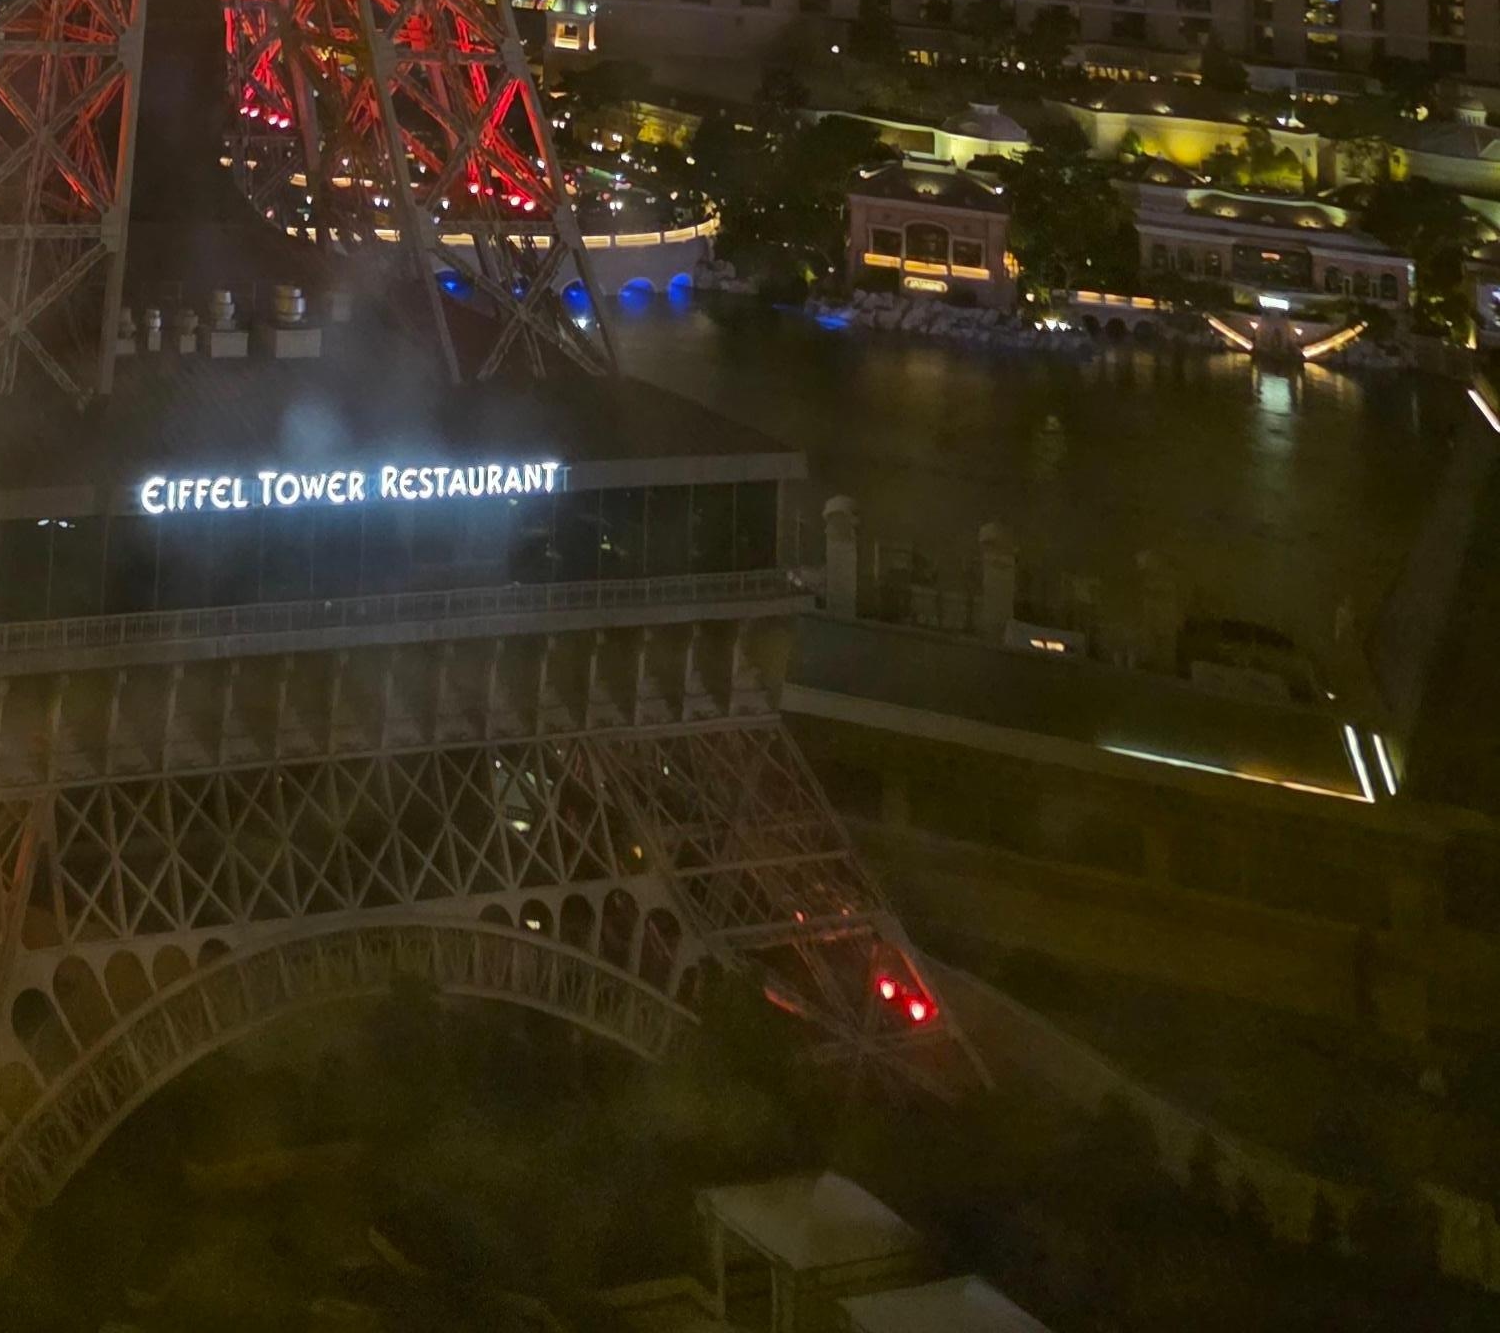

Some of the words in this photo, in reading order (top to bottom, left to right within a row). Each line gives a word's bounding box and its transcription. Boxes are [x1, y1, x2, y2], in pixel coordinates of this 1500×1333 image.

[141, 477, 248, 514] EIFFEL
[259, 471, 366, 505] TOWER
[381, 462, 560, 500] RESTAURANT
